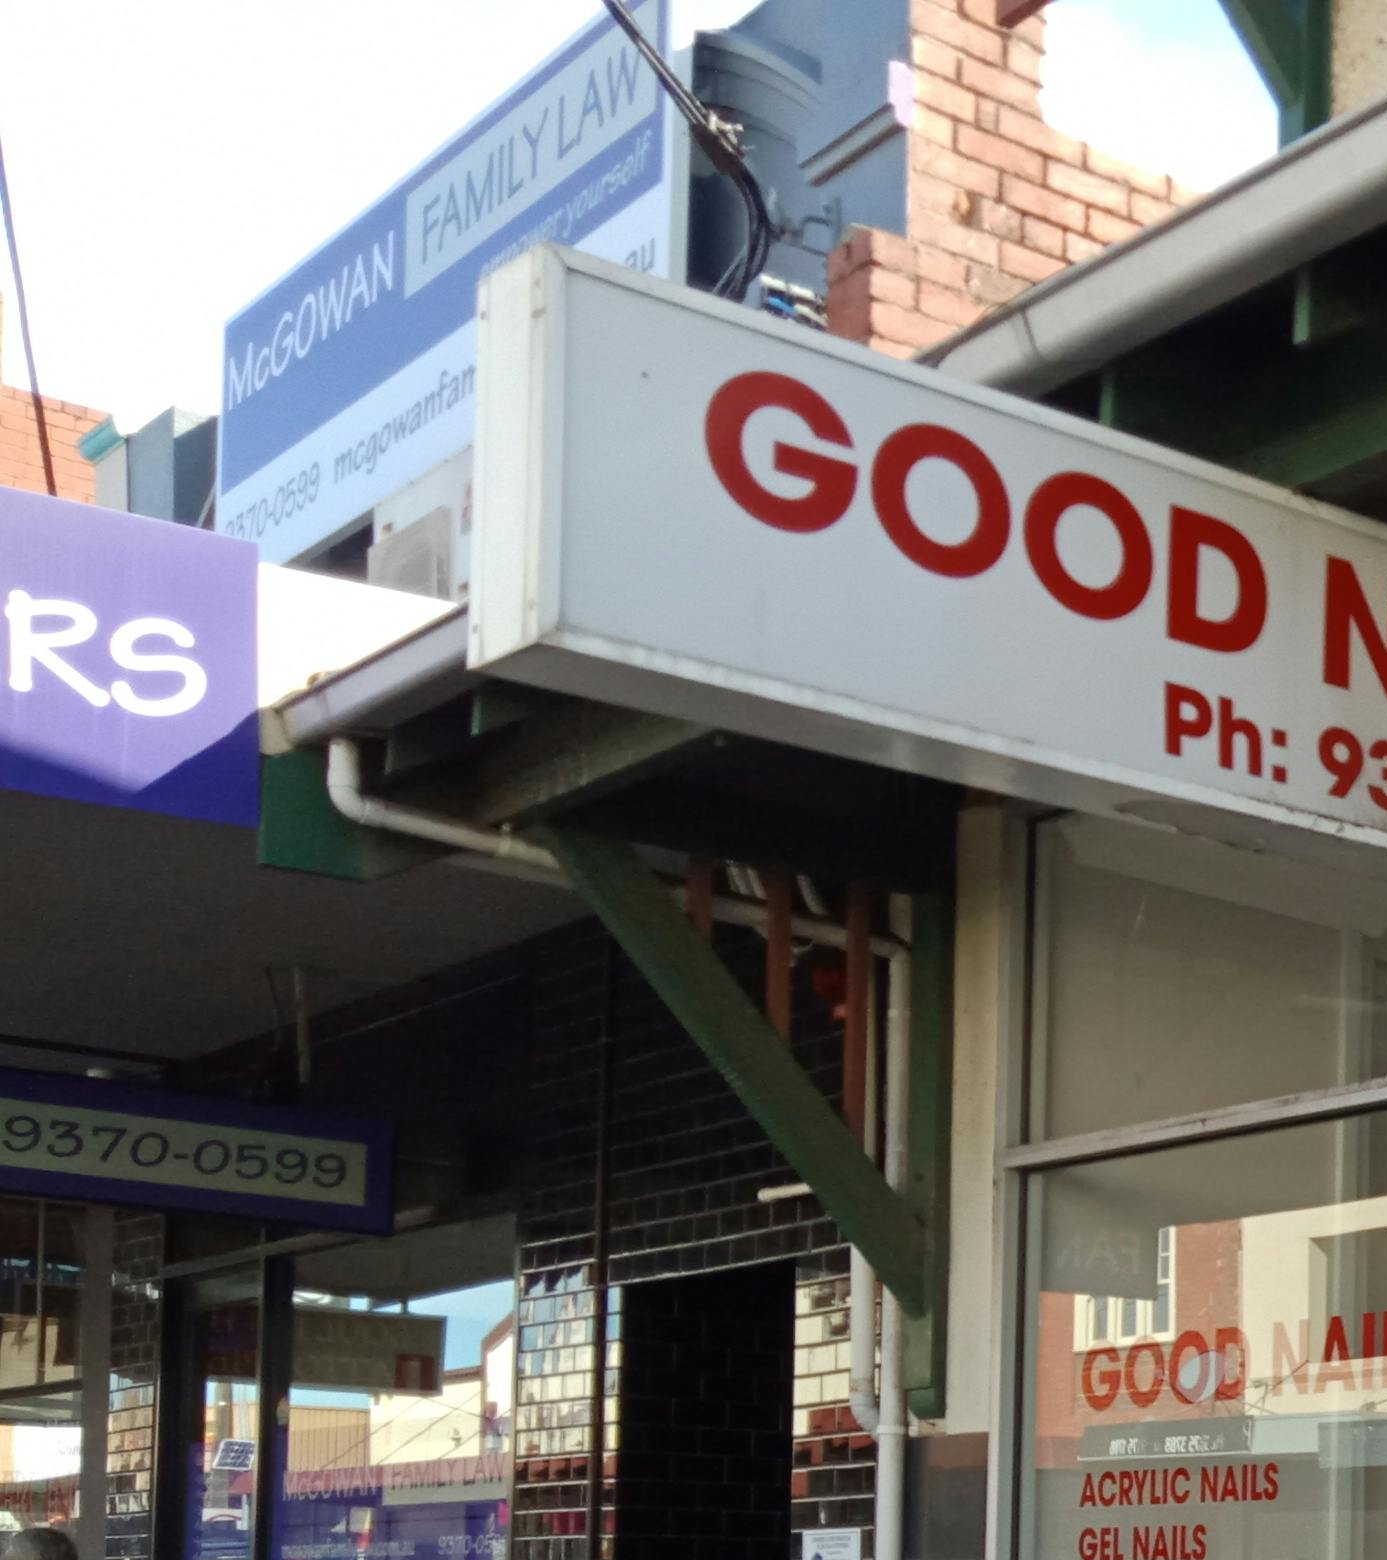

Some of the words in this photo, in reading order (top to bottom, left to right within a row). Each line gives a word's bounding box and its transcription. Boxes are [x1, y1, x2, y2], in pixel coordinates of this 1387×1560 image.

[226, 230, 397, 411] McGOWAN
[419, 107, 549, 265] FAMILY
[557, 42, 644, 160] LAW
[704, 370, 1268, 654] GOOD
[1164, 682, 1287, 784] Ph:
[2, 1114, 348, 1189] 9370-0599
[1081, 1326, 1250, 1412] GOOD
[391, 1459, 459, 1491] FAMILY
[463, 1452, 506, 1486] LAW
[1079, 1466, 1191, 1508] ACRYLIC
[1200, 1462, 1280, 1503] NAILS
